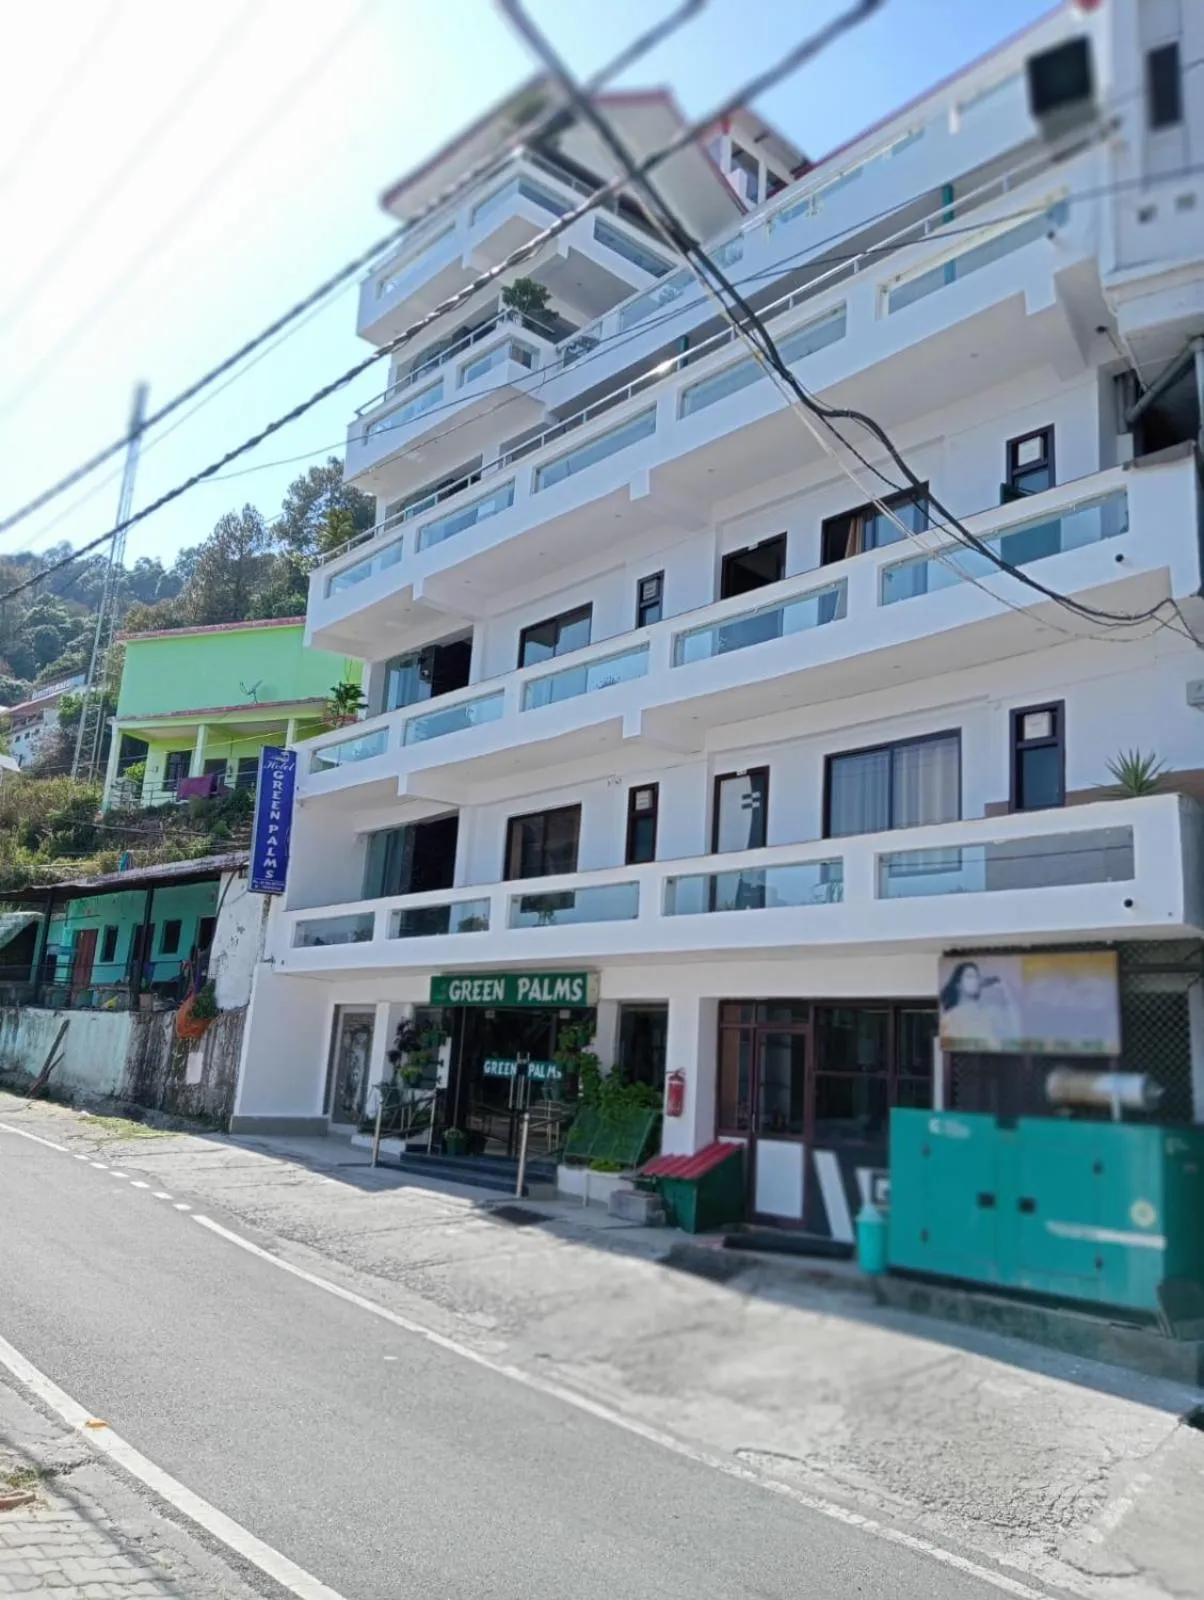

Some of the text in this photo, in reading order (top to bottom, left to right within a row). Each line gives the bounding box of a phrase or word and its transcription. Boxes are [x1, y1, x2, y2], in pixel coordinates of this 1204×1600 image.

[262, 760, 296, 771] Hotel
[269, 770, 285, 820] GREEN
[263, 824, 278, 879] PALMS
[449, 977, 584, 1001] GREEN PALMS
[484, 1060, 517, 1076] GREEN
